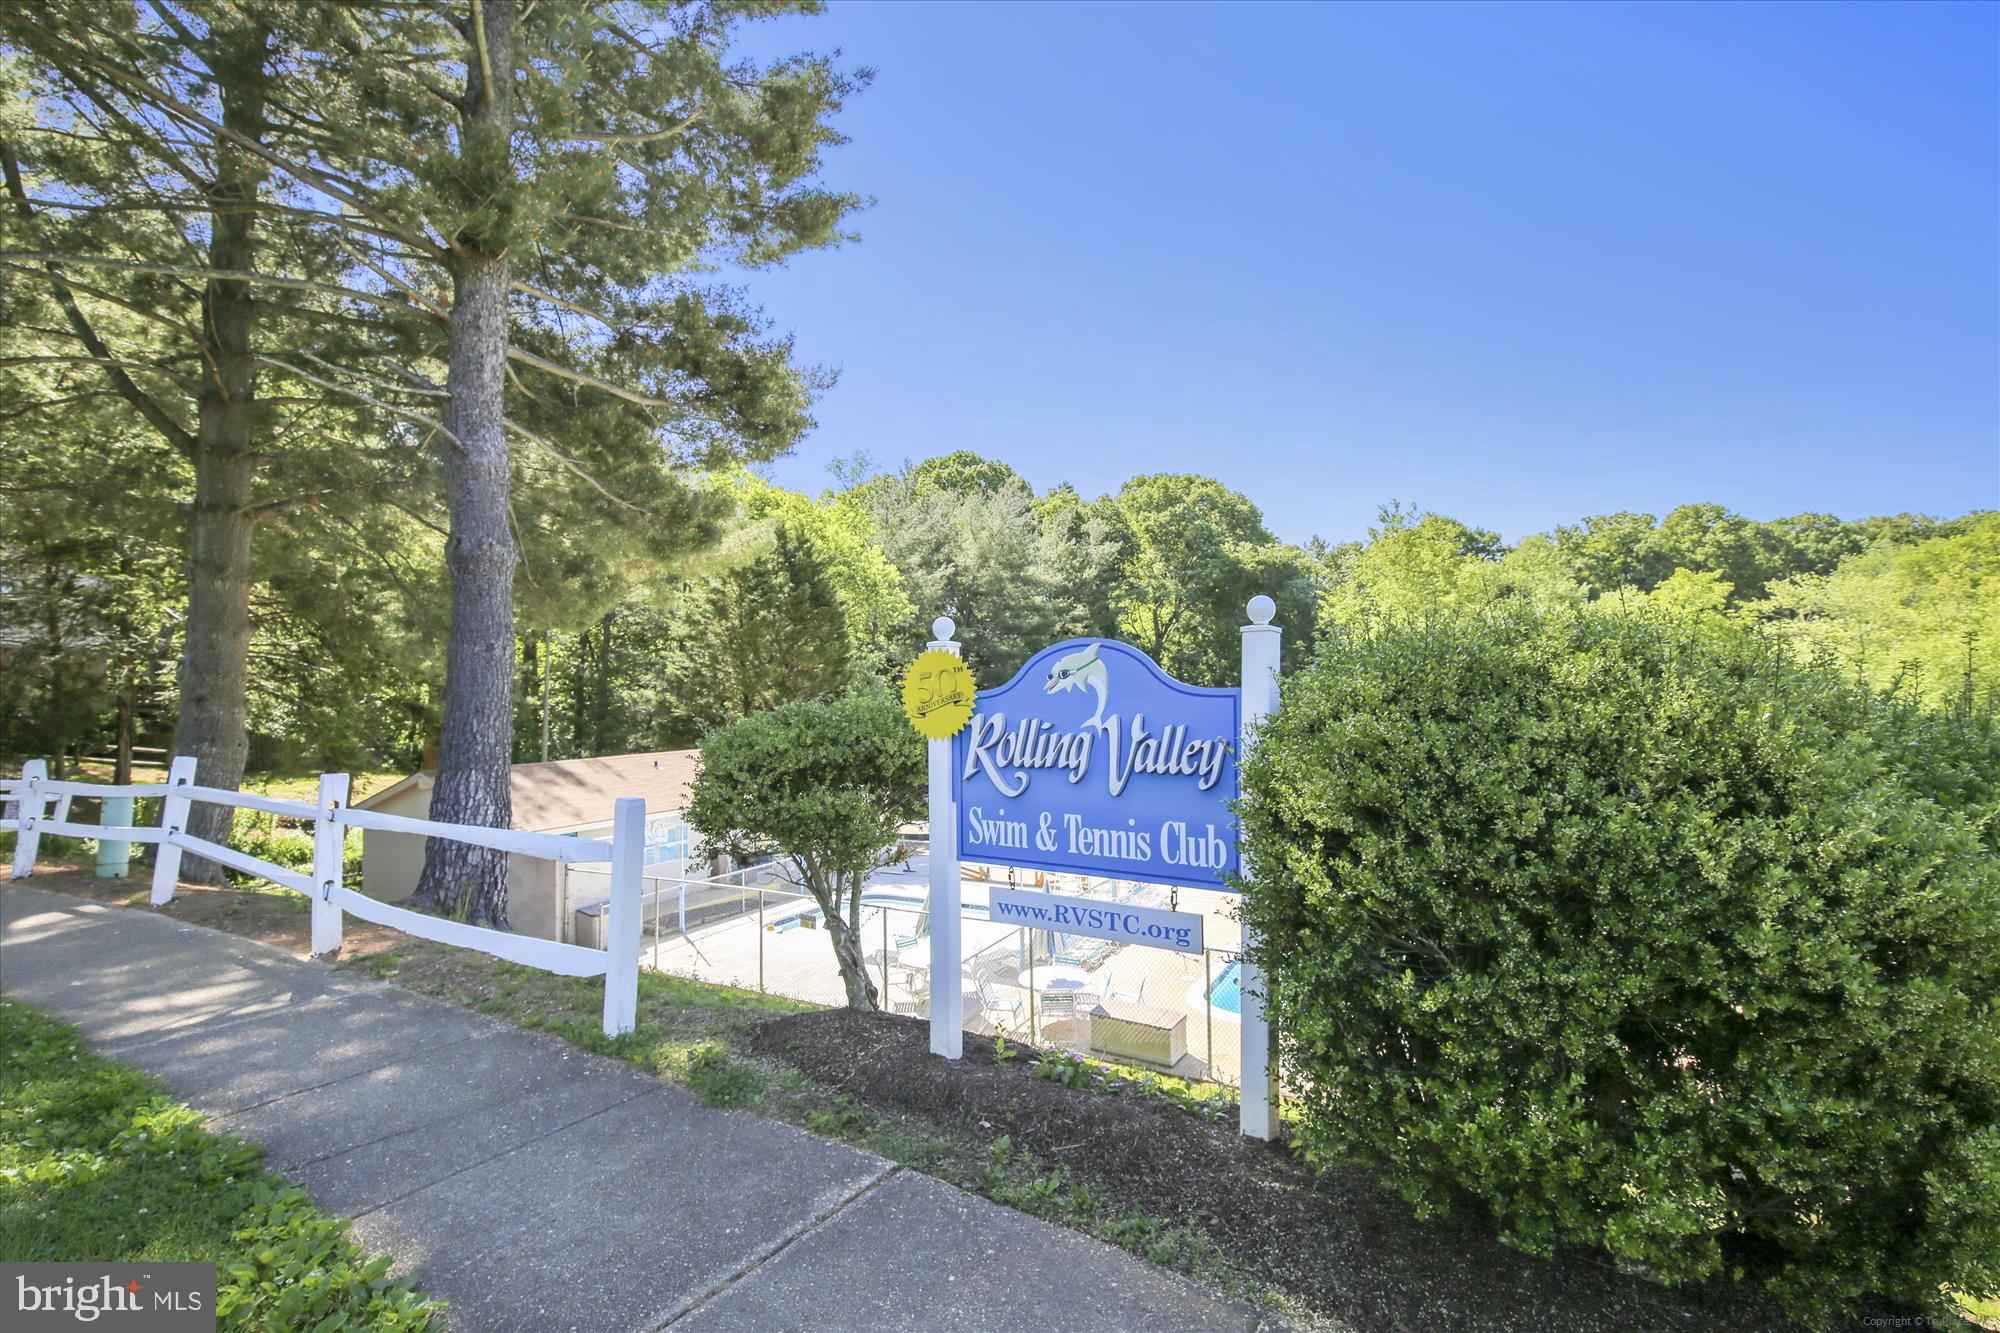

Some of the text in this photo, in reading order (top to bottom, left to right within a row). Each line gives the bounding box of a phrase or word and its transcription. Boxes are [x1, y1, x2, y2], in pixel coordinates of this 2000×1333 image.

[963, 712, 1229, 798] Rolling Valley
[968, 806, 1227, 869] Swim & Tennis Club
[997, 901, 1191, 947] www.RVSTC.org
